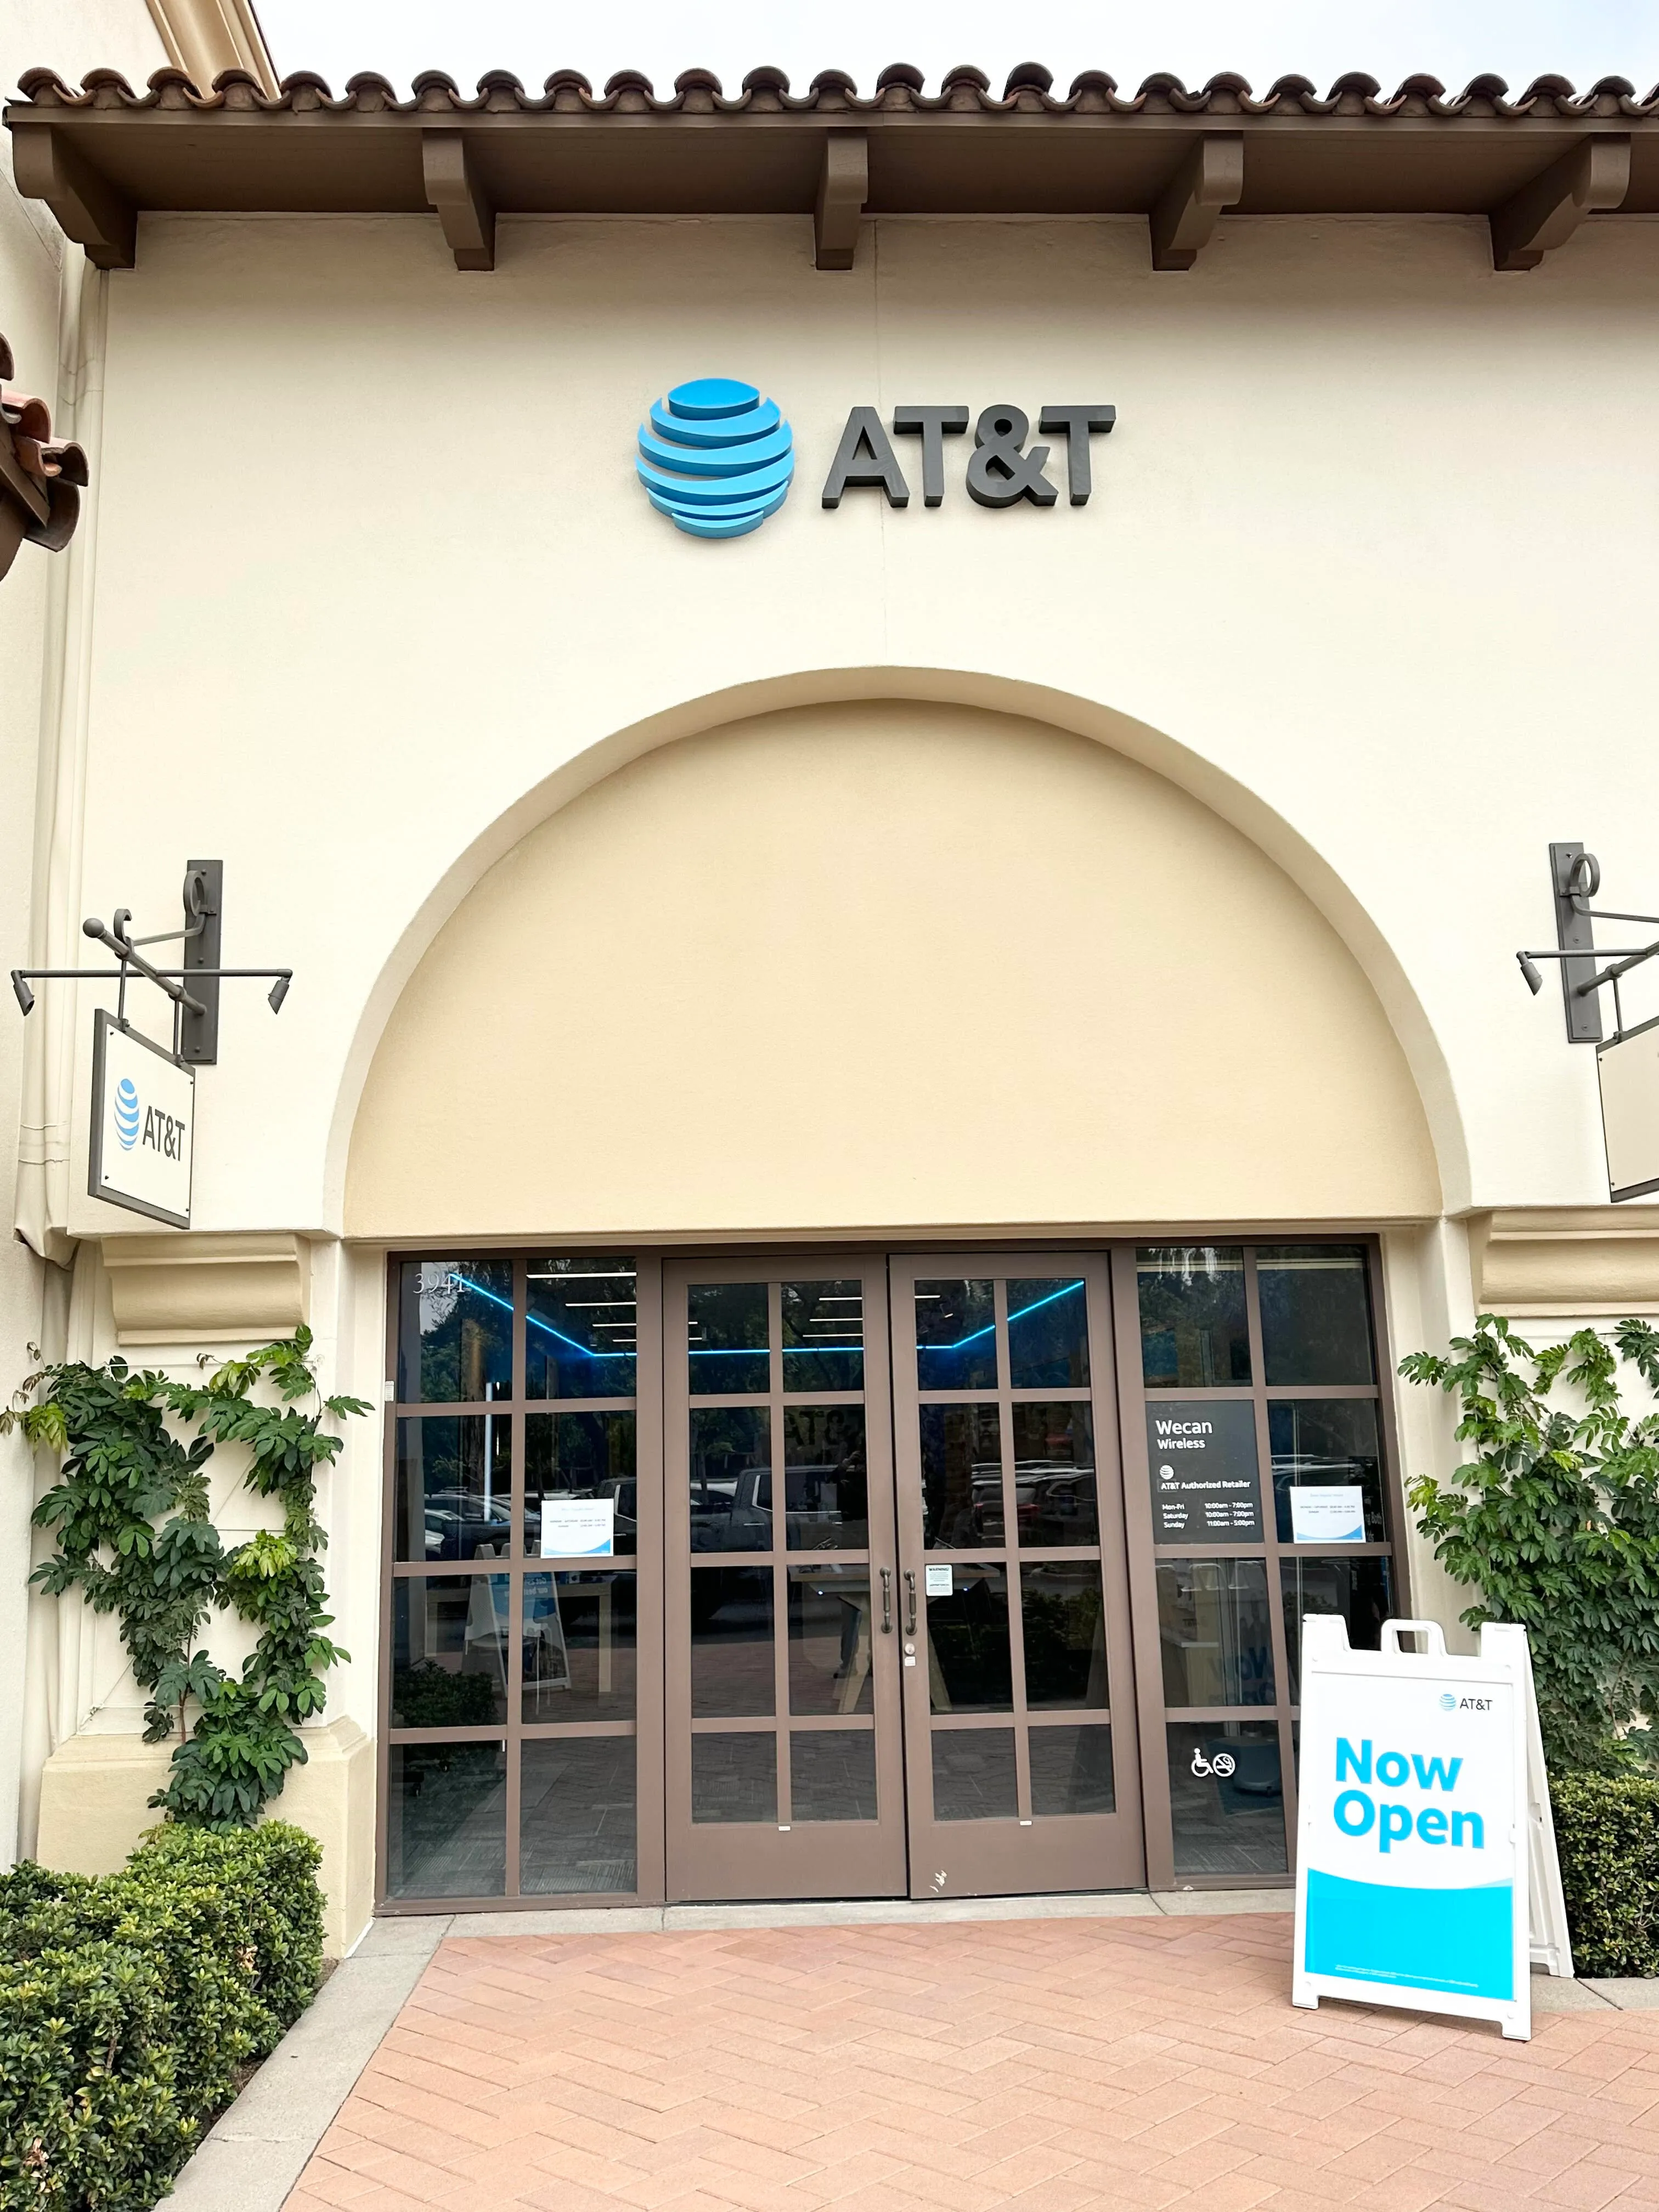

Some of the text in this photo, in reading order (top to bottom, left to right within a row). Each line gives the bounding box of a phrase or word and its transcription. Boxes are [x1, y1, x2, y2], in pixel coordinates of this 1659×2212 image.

[822, 404, 1116, 509] AT&T
[142, 1105, 185, 1161] AT&T
[413, 1272, 465, 1295] 3941
[1155, 1420, 1212, 1435] Wecan
[1157, 1437, 1206, 1449] Wireless
[1181, 1481, 1221, 1490] Authorized
[1222, 1480, 1251, 1488] Retailer
[1459, 1697, 1493, 1711] AT&T
[1335, 1737, 1464, 1792] Now
[1334, 1790, 1485, 1854] Open
